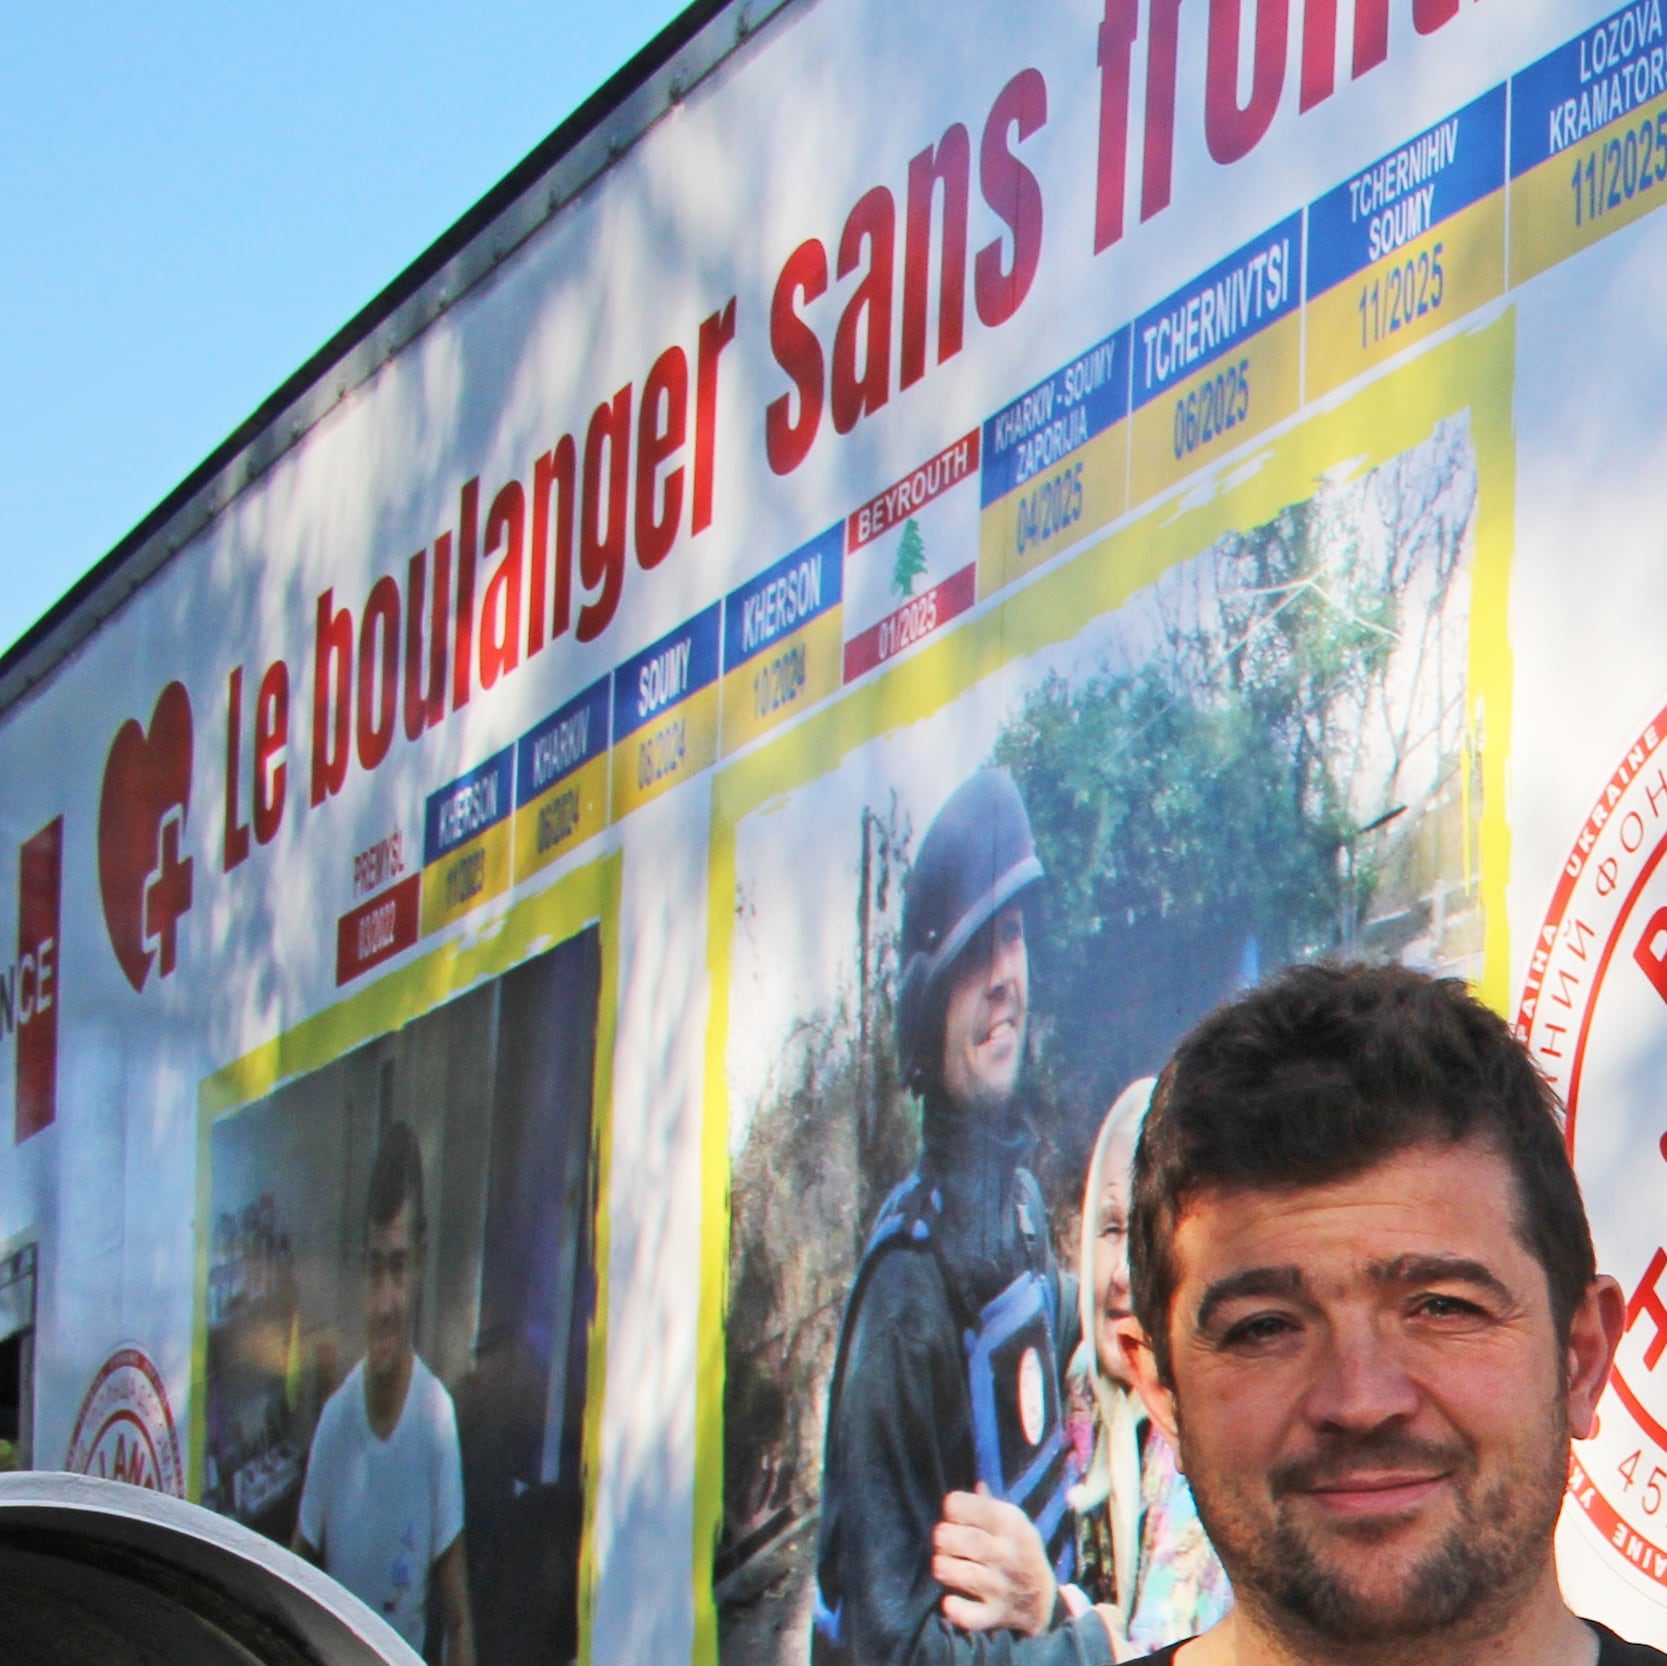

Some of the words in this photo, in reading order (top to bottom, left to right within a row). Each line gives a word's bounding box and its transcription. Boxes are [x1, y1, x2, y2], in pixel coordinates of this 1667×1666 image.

[1580, 0, 1663, 83] LOZOVA
[1349, 119, 1458, 222] TCHERNIHIV
[1368, 184, 1435, 262] SOUMY
[1143, 239, 1288, 388] TCHERNIVTSI
[1359, 243, 1443, 349] 11/2025
[995, 380, 1055, 453] KHARKIV
[1064, 340, 1114, 406] SOUMY
[1173, 359, 1248, 460] 06/2025
[223, 659, 289, 873] Le
[310, 295, 737, 809] boulanger
[765, 67, 1048, 475] sans
[858, 441, 968, 542] BEYROUTH
[743, 553, 822, 652] KHERSON
[879, 591, 938, 660] 01/2025
[638, 638, 692, 717] SOUMY
[533, 704, 590, 789] KHARKIV
[438, 770, 498, 848] KHERSON
[1566, 725, 1660, 878] UKRAINE
[1539, 918, 1596, 1083] НИЙ
